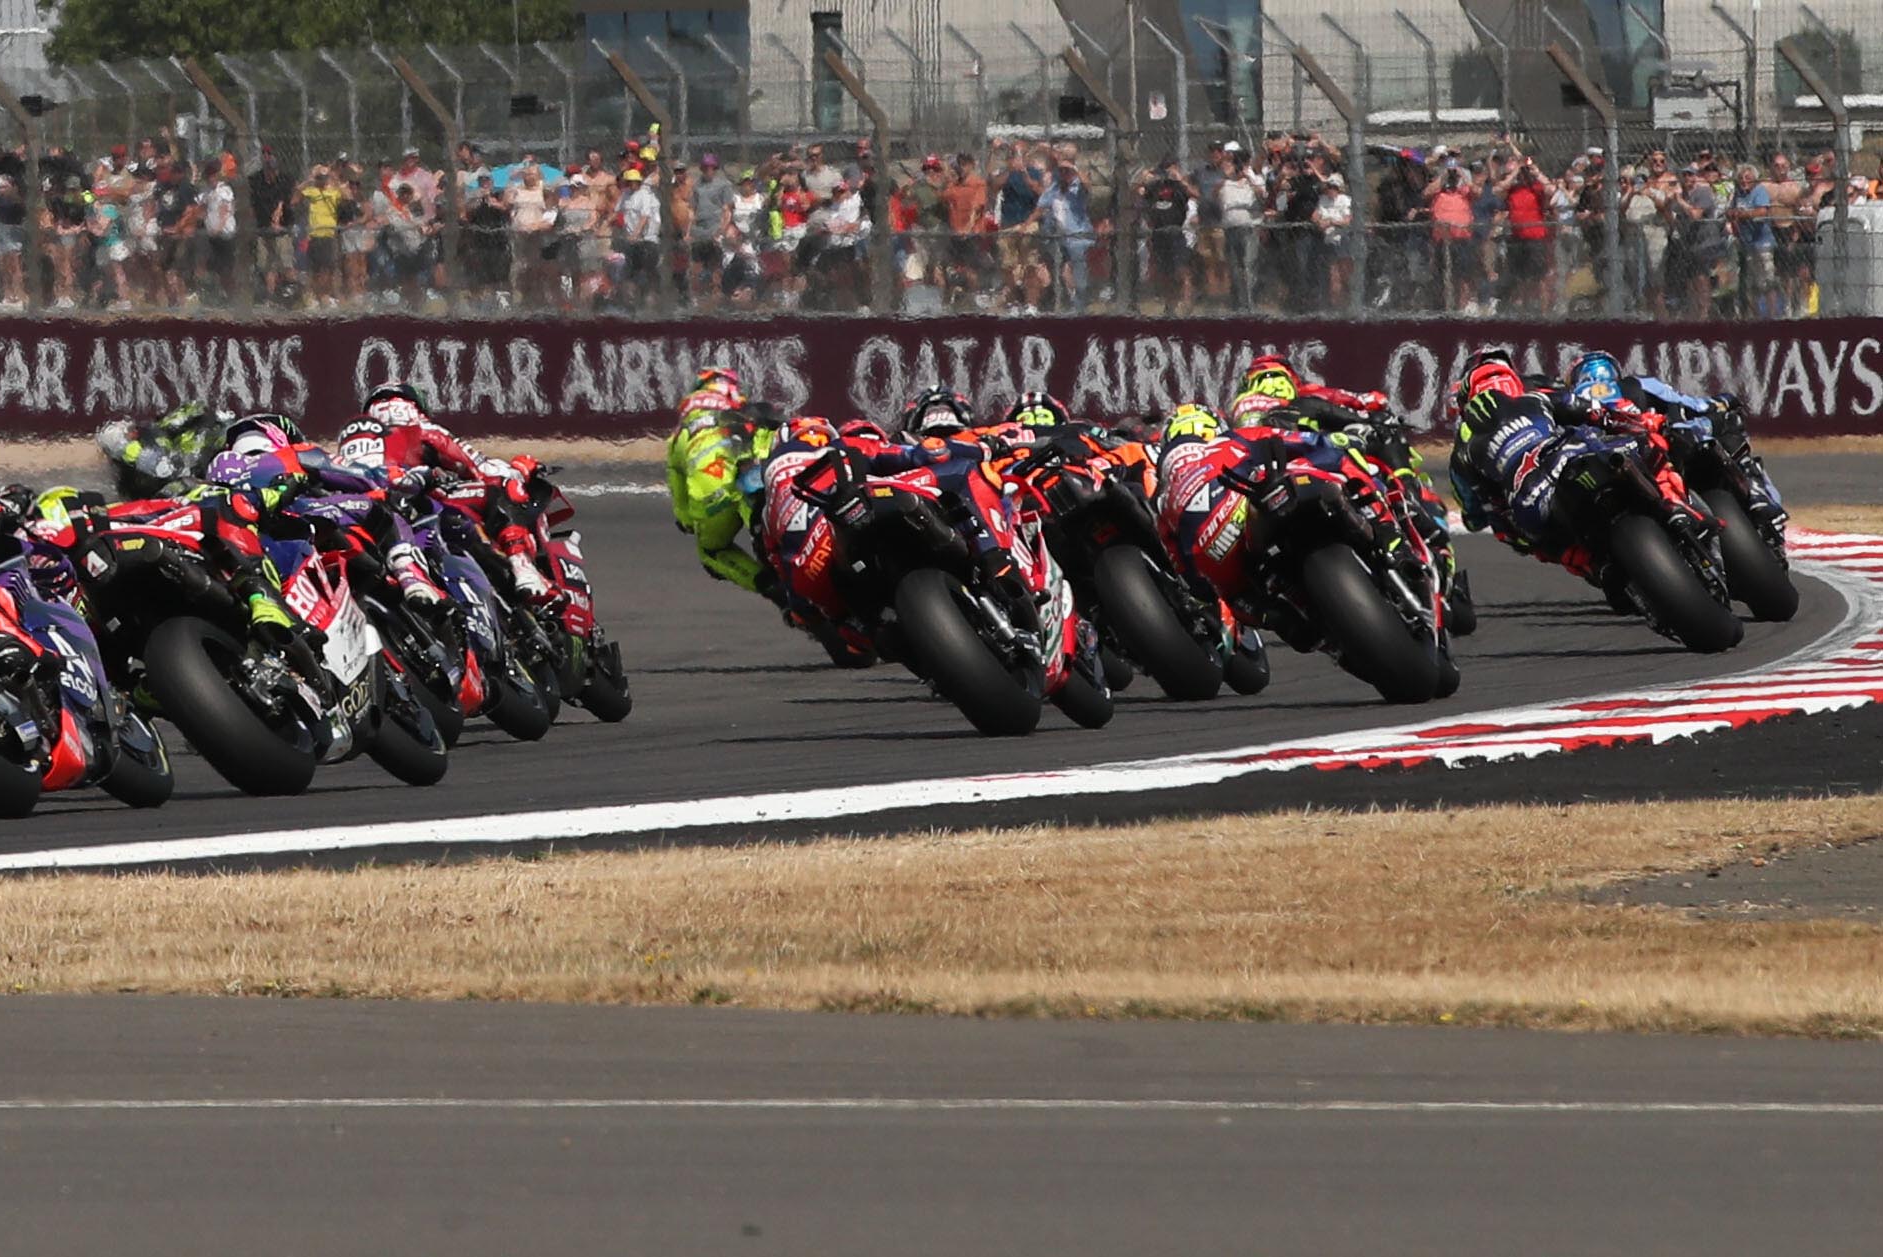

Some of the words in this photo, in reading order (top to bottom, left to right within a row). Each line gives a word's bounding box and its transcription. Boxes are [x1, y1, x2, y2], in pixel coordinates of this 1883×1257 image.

[85, 334, 310, 418] AIRWAYS
[353, 335, 553, 415] QATAR
[847, 334, 1055, 430] QATAR
[1068, 333, 1328, 415] AIRWS
